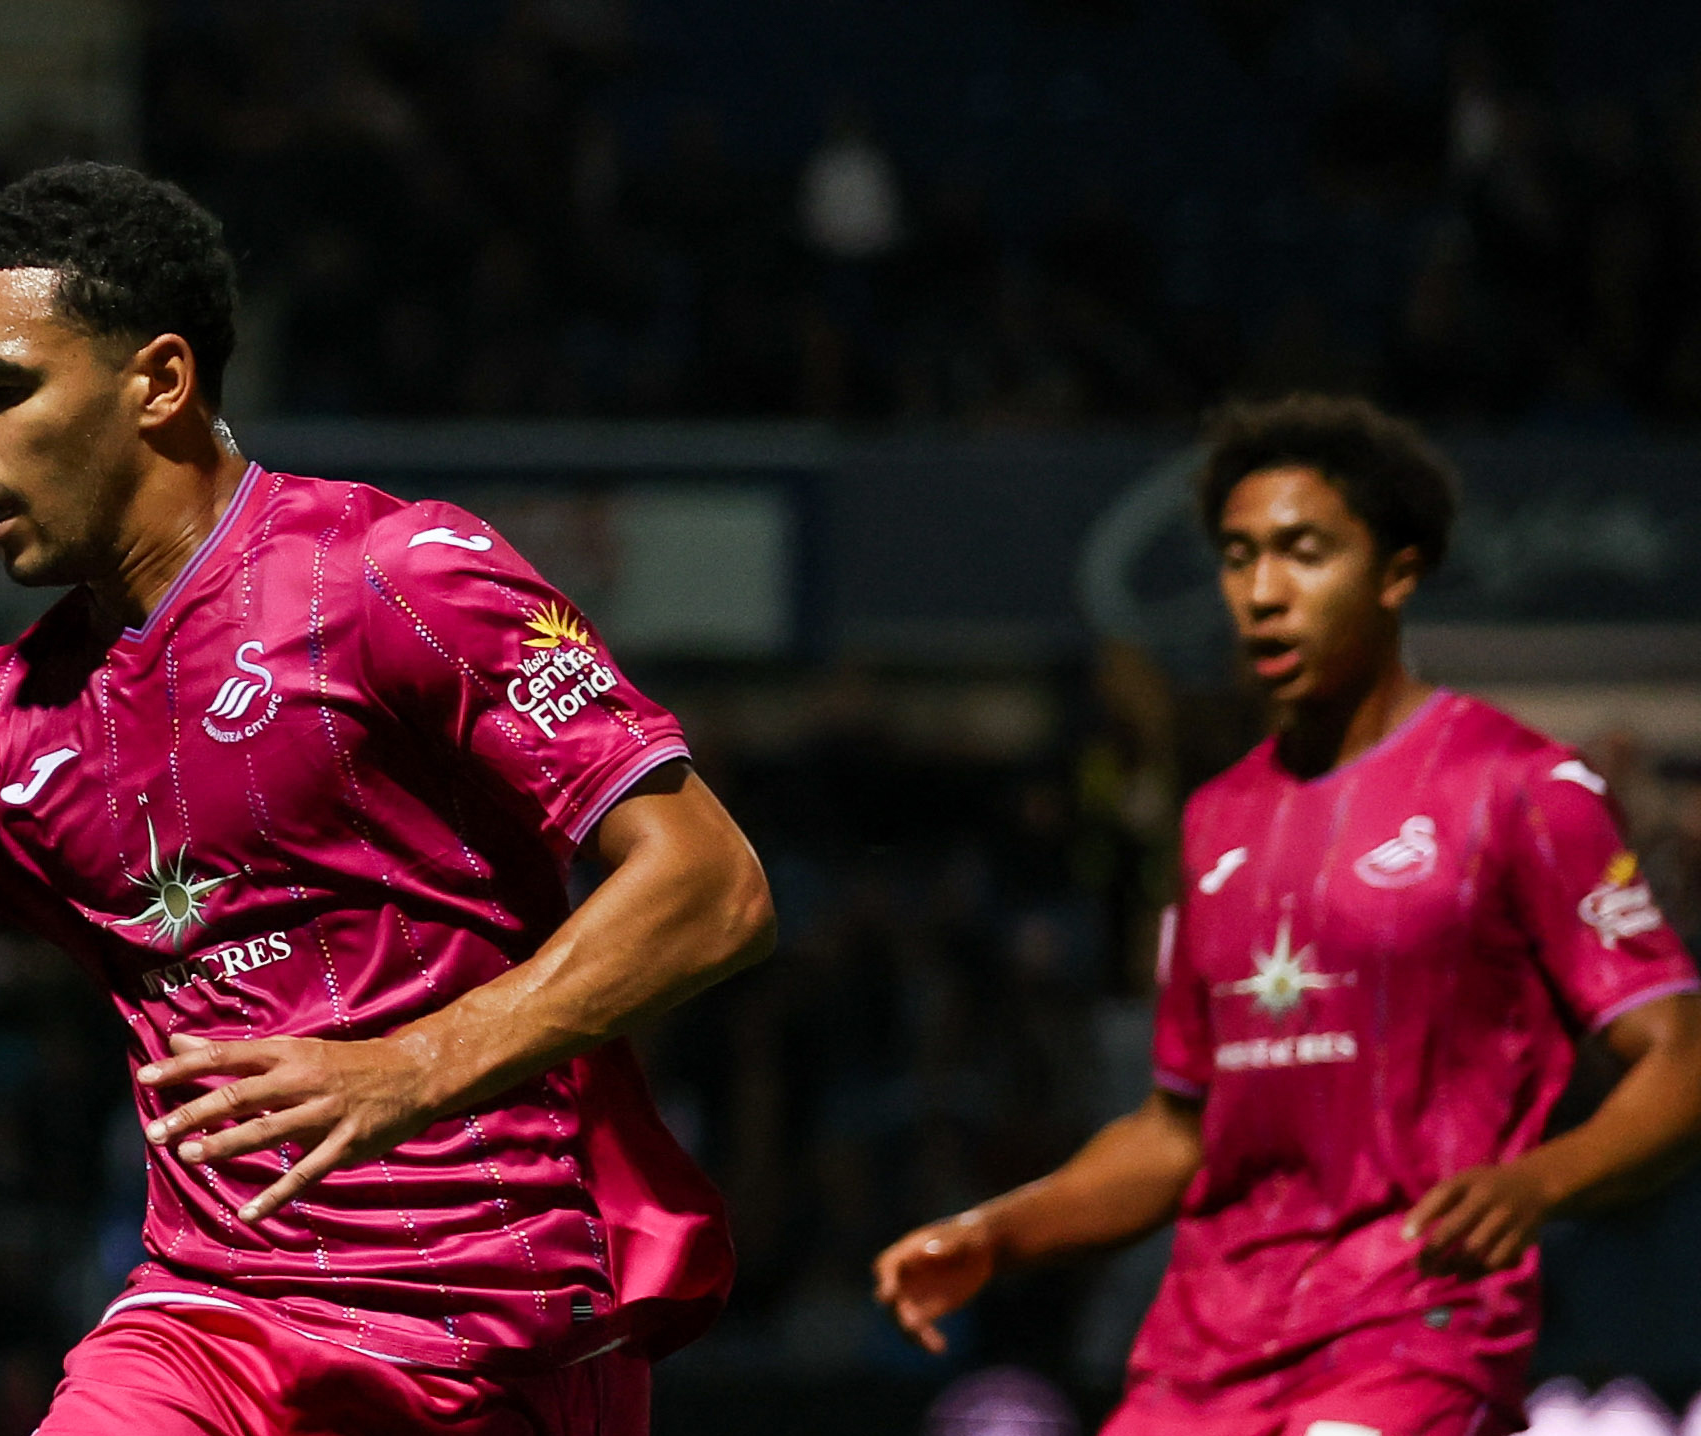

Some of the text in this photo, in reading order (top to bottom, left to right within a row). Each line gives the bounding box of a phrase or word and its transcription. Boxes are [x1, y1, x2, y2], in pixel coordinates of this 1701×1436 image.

[506, 647, 595, 713] Centra
[517, 649, 551, 677] Visit
[200, 692, 283, 743] SWANSEA CITY AFC
